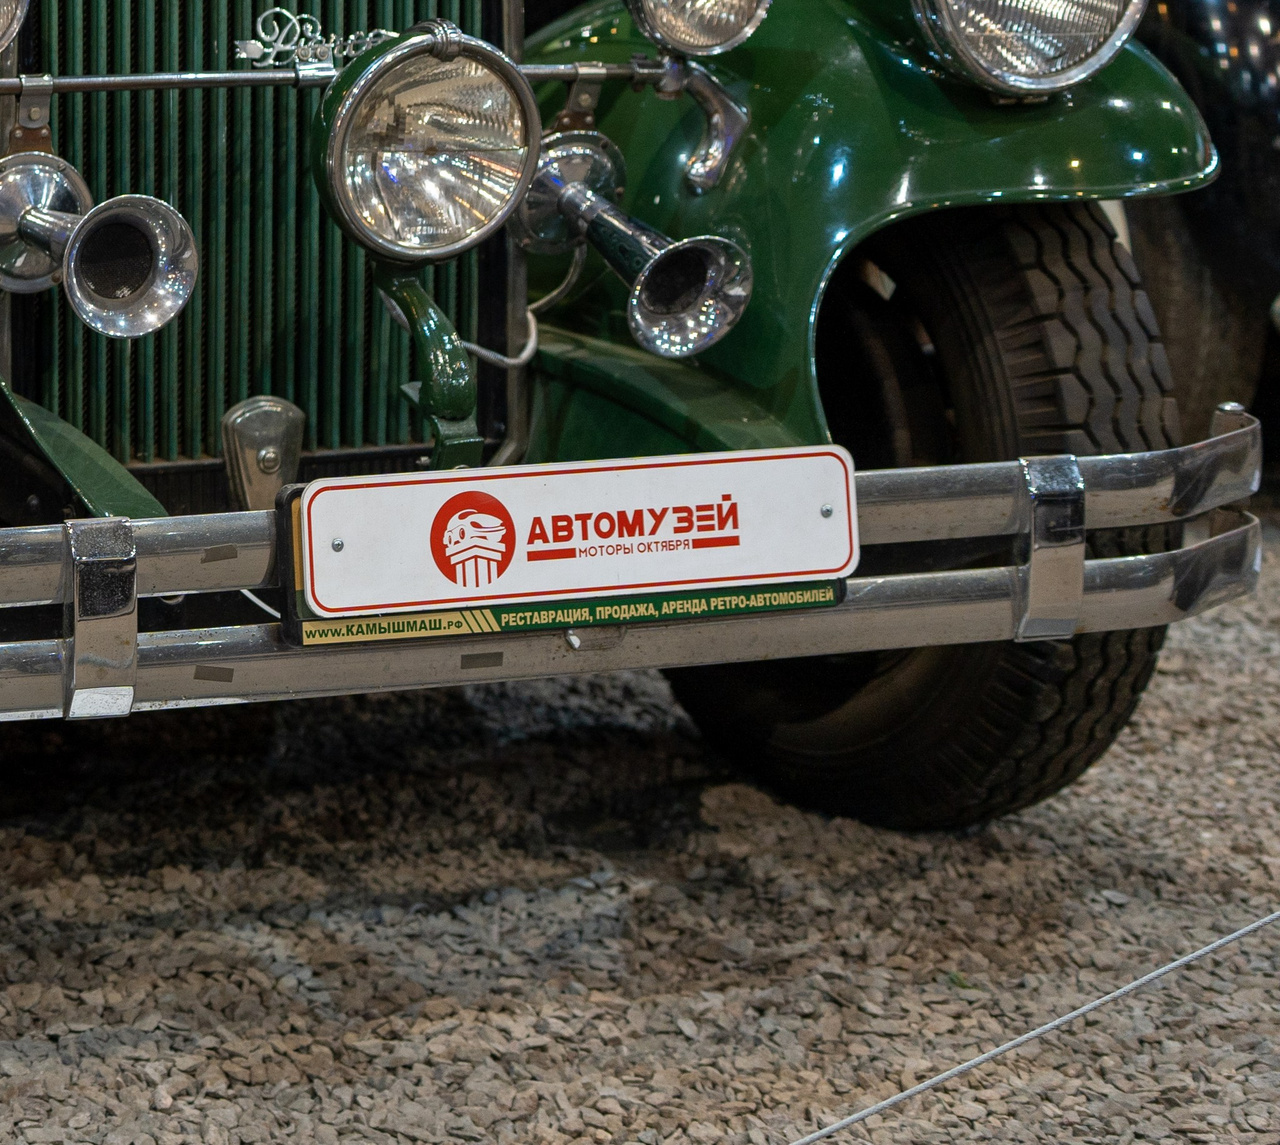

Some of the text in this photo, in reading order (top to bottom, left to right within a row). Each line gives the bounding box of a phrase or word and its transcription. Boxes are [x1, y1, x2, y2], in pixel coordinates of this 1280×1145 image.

[527, 494, 739, 545] АВТОМУЗЕЙ
[579, 539, 690, 557] МОТОРЫ ОКТЯБРЯ
[501, 586, 834, 627] РЕСТАВРАЦИЯ, ПРОДАЖА, АРЕНДА РЕТРО-АВТОМОБИЛЕЙ
